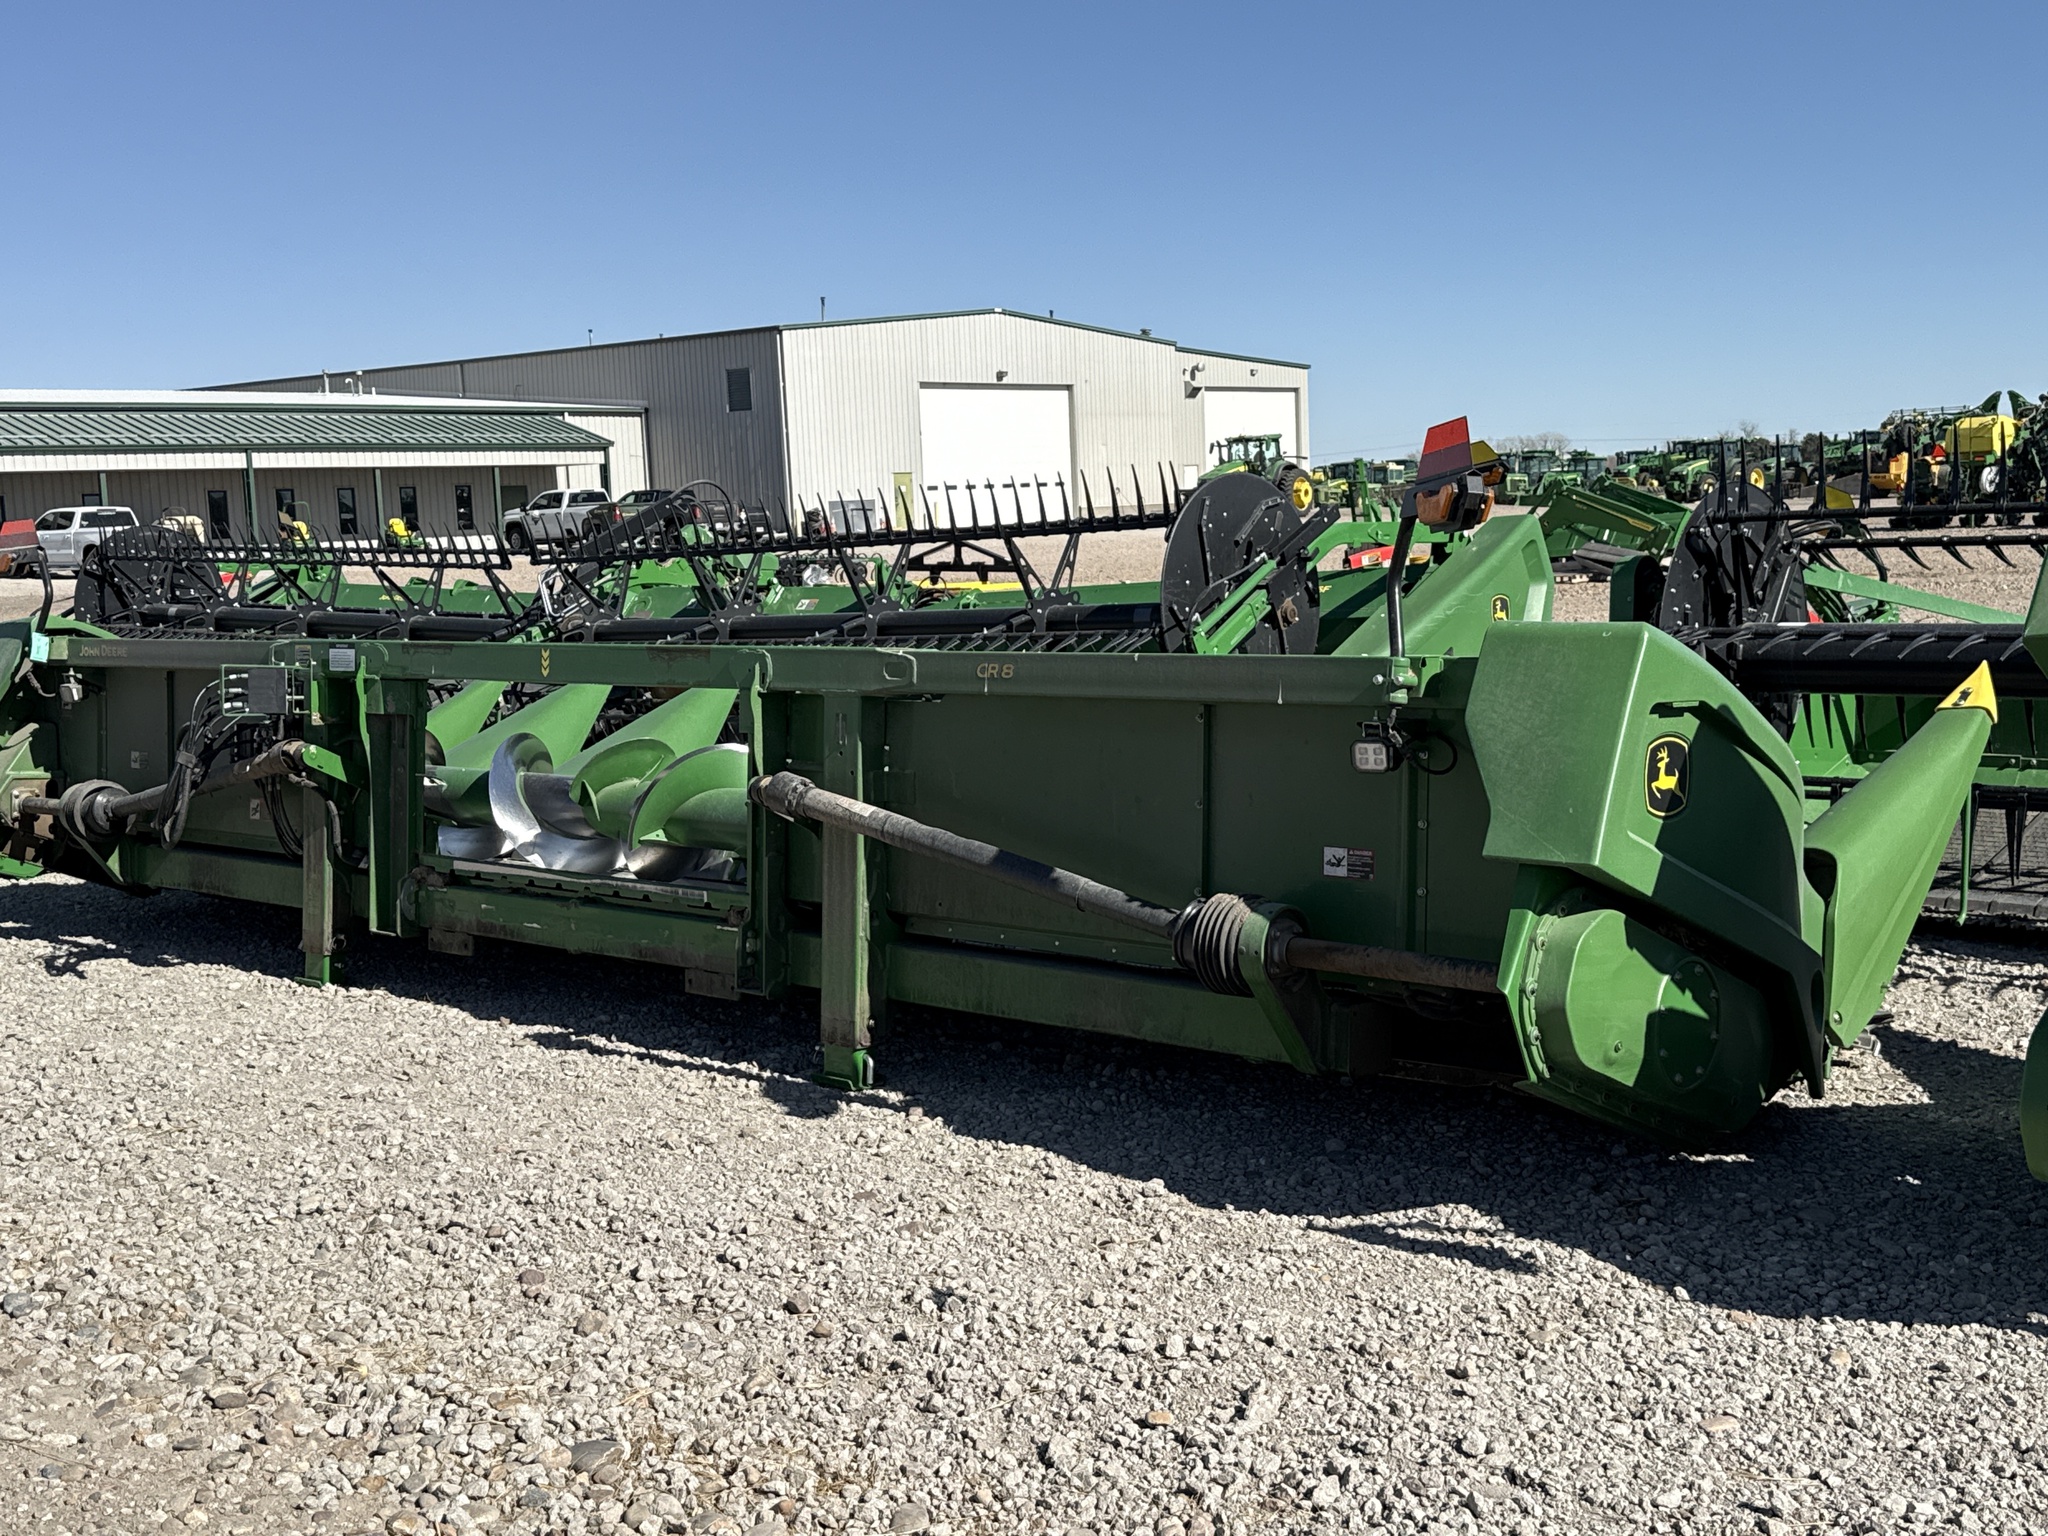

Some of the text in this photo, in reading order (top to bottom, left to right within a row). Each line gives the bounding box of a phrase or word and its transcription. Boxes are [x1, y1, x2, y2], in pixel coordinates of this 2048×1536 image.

[80, 645, 128, 657] JOHN DEERE
[976, 663, 1014, 679] CR 8
